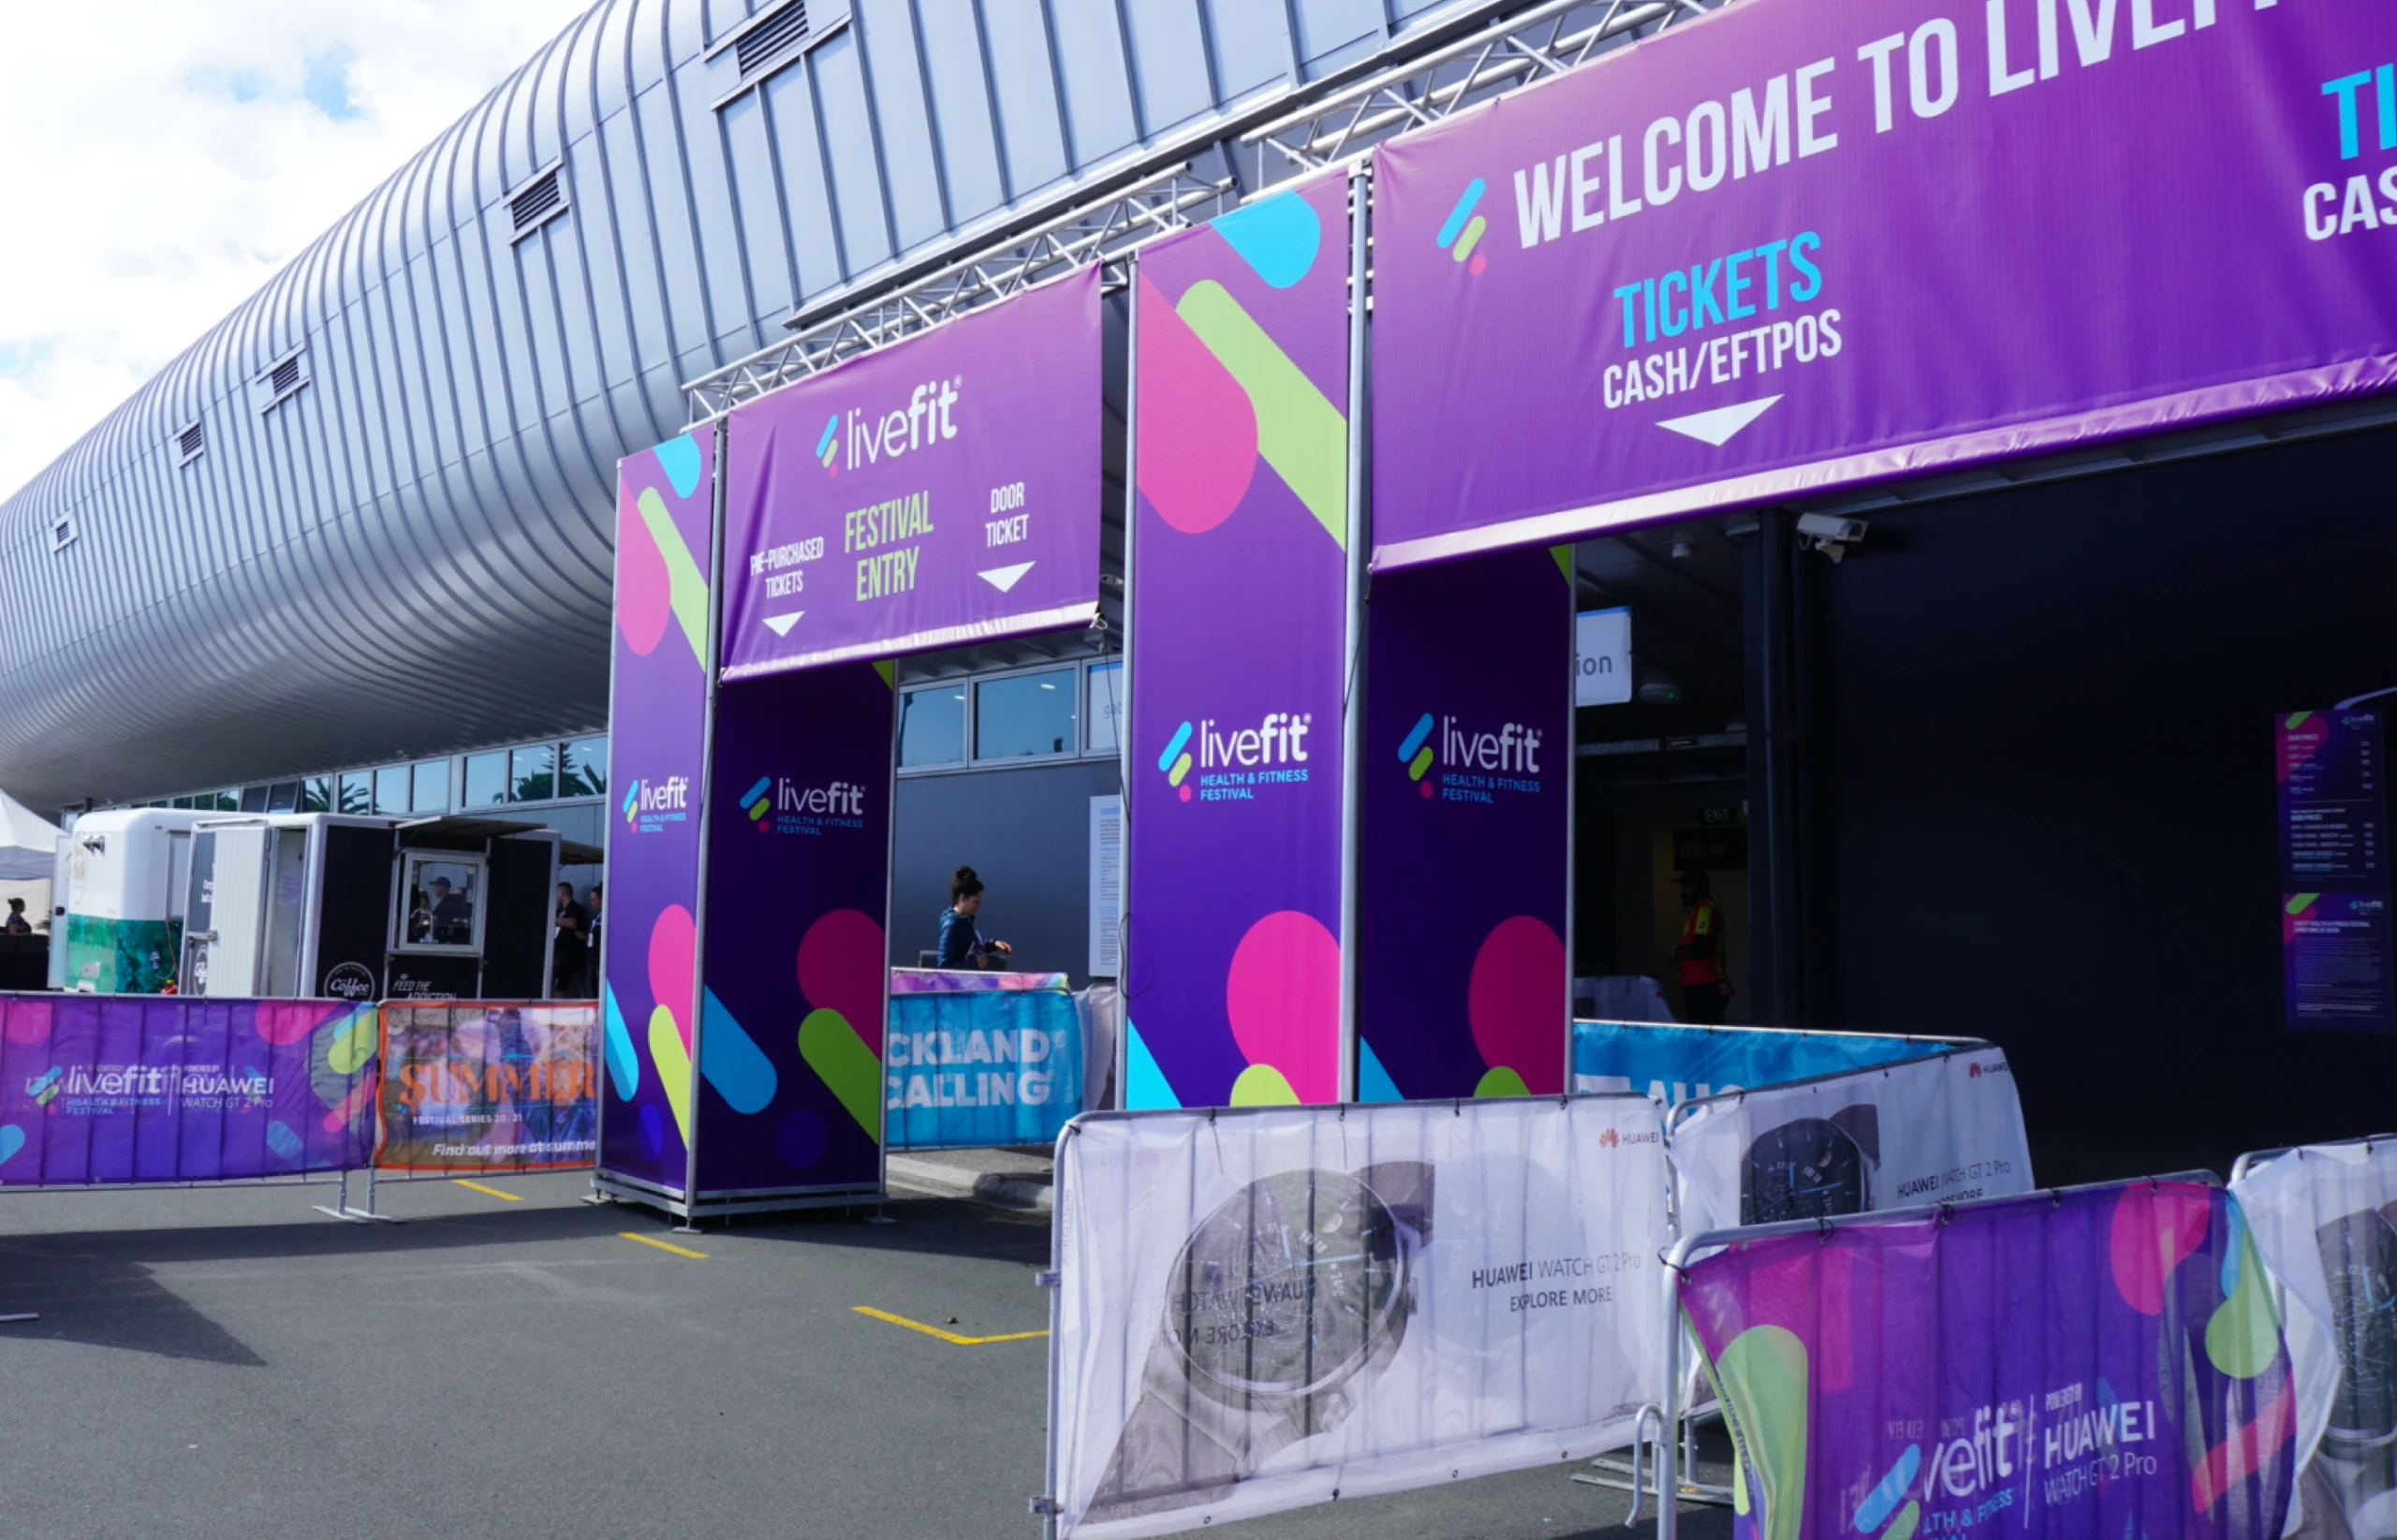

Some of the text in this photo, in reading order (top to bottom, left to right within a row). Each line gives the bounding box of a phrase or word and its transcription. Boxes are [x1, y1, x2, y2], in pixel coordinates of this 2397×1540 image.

[1513, 57, 1838, 249] WELCOME
[1858, 18, 1959, 133] TO
[1614, 230, 1823, 348] TICKETS
[1603, 308, 1843, 409] CASH/EFTPOS
[847, 380, 958, 471] livefit
[991, 482, 1024, 513] DOOR
[845, 490, 934, 553] FESTIVAL
[986, 514, 1029, 548] TICKET
[750, 535, 824, 577] PRE-PURCHASED
[765, 570, 803, 599] TICKETS
[856, 546, 919, 602] ENTRY
[1576, 653, 1612, 677] ion
[1200, 712, 1309, 767] livefit
[1443, 716, 1540, 774] livefit
[1199, 769, 1309, 787] HEALTH & FITNESS
[1442, 773, 1540, 793] HEALTH & FITNESS
[640, 776, 688, 811] livefit
[777, 777, 863, 815] livefit
[1199, 787, 1255, 801] FESTIVAL
[1442, 787, 1494, 804] FESTIVAL
[640, 812, 686, 823] HEALTH & FITNESS
[640, 823, 663, 833] FESTIVAL
[776, 815, 863, 829] HEALTH & FITNESS
[776, 825, 822, 835] FESTIVAL
[331, 978, 370, 997] Coffee
[67, 1064, 162, 1094] livefit
[182, 1078, 274, 1094] HUAWEI
[399, 1062, 597, 1107] SUMMER
[888, 1070, 1050, 1109] CALLING
[182, 1096, 273, 1108] WATCH GT 2 Pro
[413, 1115, 456, 1125] FESTIVAL
[459, 1114, 493, 1124] SERIES
[433, 1143, 464, 1157] Find
[467, 1144, 491, 1157] out
[493, 1144, 525, 1156] more
[529, 1141, 544, 1153] at
[1622, 1131, 1658, 1144] HUAWEI
[1897, 1176, 1938, 1198] HUAWEI
[1968, 1163, 1982, 1180] GT
[1986, 1163, 1994, 1177] 2
[1994, 1160, 2011, 1176] Pro
[1472, 1252, 1641, 1289] HUAWEI WATCH GT 2 Pro
[1510, 1286, 1613, 1313] EXPLORE MORE
[2045, 1401, 2154, 1470] HUAWEI
[2045, 1452, 2157, 1504] WATCH GT 2 Pro
[1961, 1508, 1973, 1528] &
